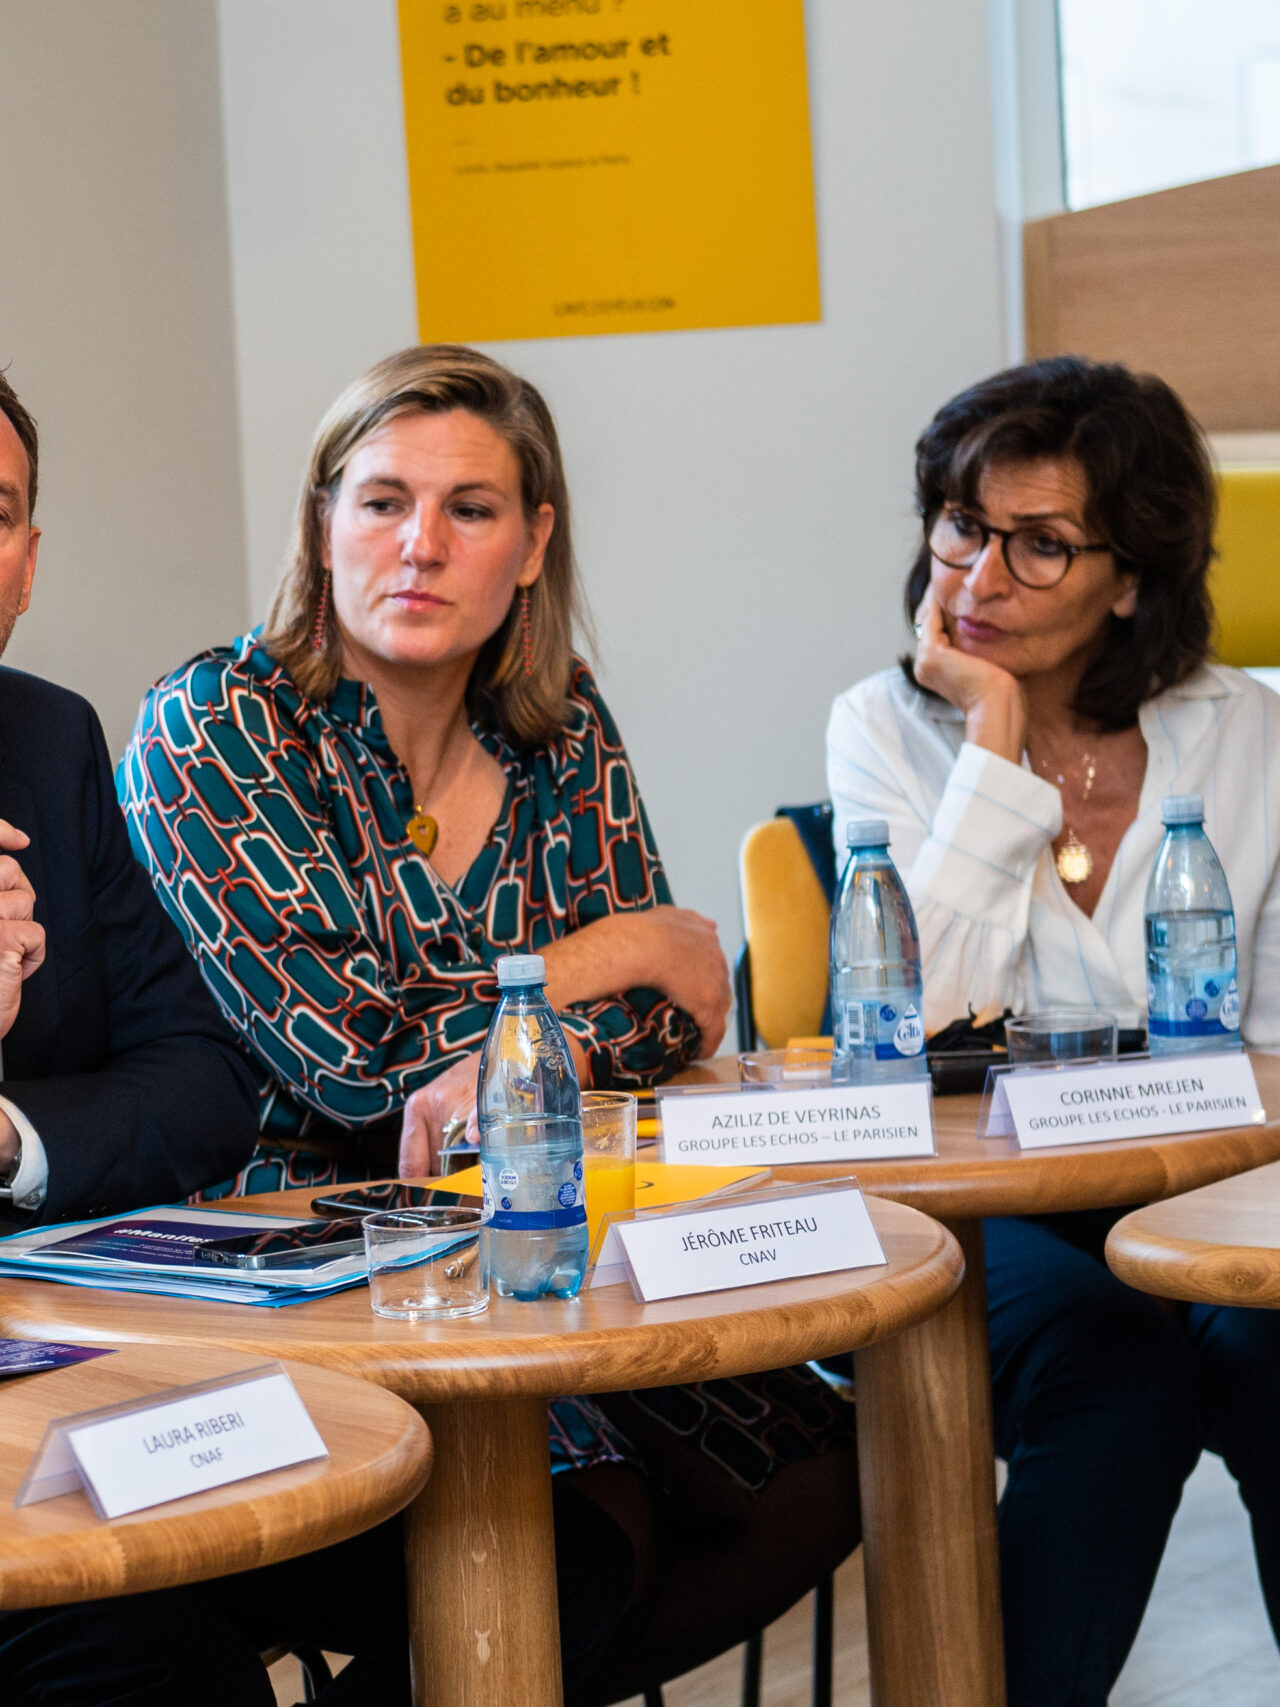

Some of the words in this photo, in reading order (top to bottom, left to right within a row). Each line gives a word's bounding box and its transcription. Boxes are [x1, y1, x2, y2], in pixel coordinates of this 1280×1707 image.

[464, 43, 507, 68] De
[515, 40, 629, 65] l'amour
[639, 31, 671, 57] et
[445, 81, 485, 106] du
[493, 74, 620, 103] bonheur
[1059, 1083, 1135, 1107] CORINNE
[1137, 1077, 1205, 1098] MREJEN
[711, 1111, 764, 1130] AZILIZ
[767, 1109, 792, 1126] DE
[794, 1104, 882, 1125] VEYRINAS
[1028, 1112, 1086, 1132] GROUPE
[1087, 1108, 1112, 1124] LES
[1113, 1104, 1160, 1123] ECHOS
[1168, 1102, 1185, 1117] LE
[1186, 1095, 1248, 1114] PARISIEN
[677, 1135, 740, 1153] GROUPE
[742, 1133, 768, 1149] LES
[769, 1130, 819, 1147] ECHOS
[833, 1129, 850, 1143] LE
[852, 1125, 919, 1142] PARISIEN
[681, 1226, 749, 1252] JÉRÔME
[749, 1216, 818, 1242] FRITEAU
[739, 1248, 777, 1266] CNAV
[141, 1425, 197, 1455] LAURA
[195, 1411, 246, 1440] RIBERI
[190, 1447, 224, 1469] CNAF
